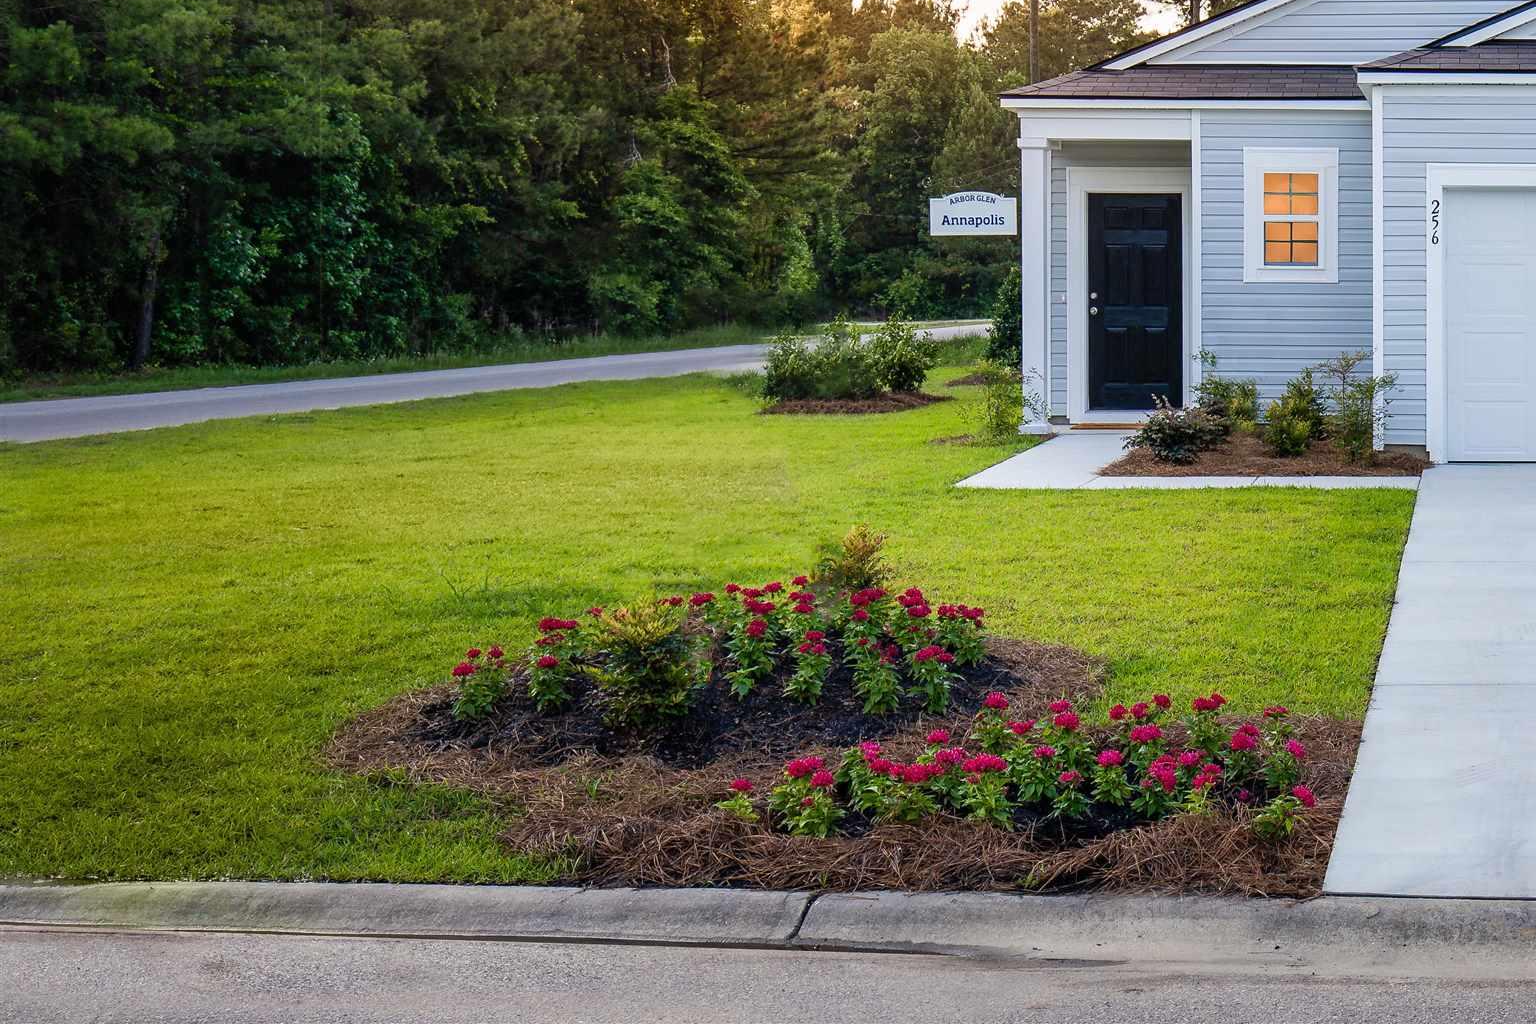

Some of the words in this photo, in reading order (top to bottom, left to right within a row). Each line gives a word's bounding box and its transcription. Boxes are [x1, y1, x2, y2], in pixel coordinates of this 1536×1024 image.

[949, 195, 975, 206] ARBOR
[976, 195, 997, 204] GLEN
[942, 214, 1005, 228] Annapolis
[1431, 199, 1440, 245] 256
